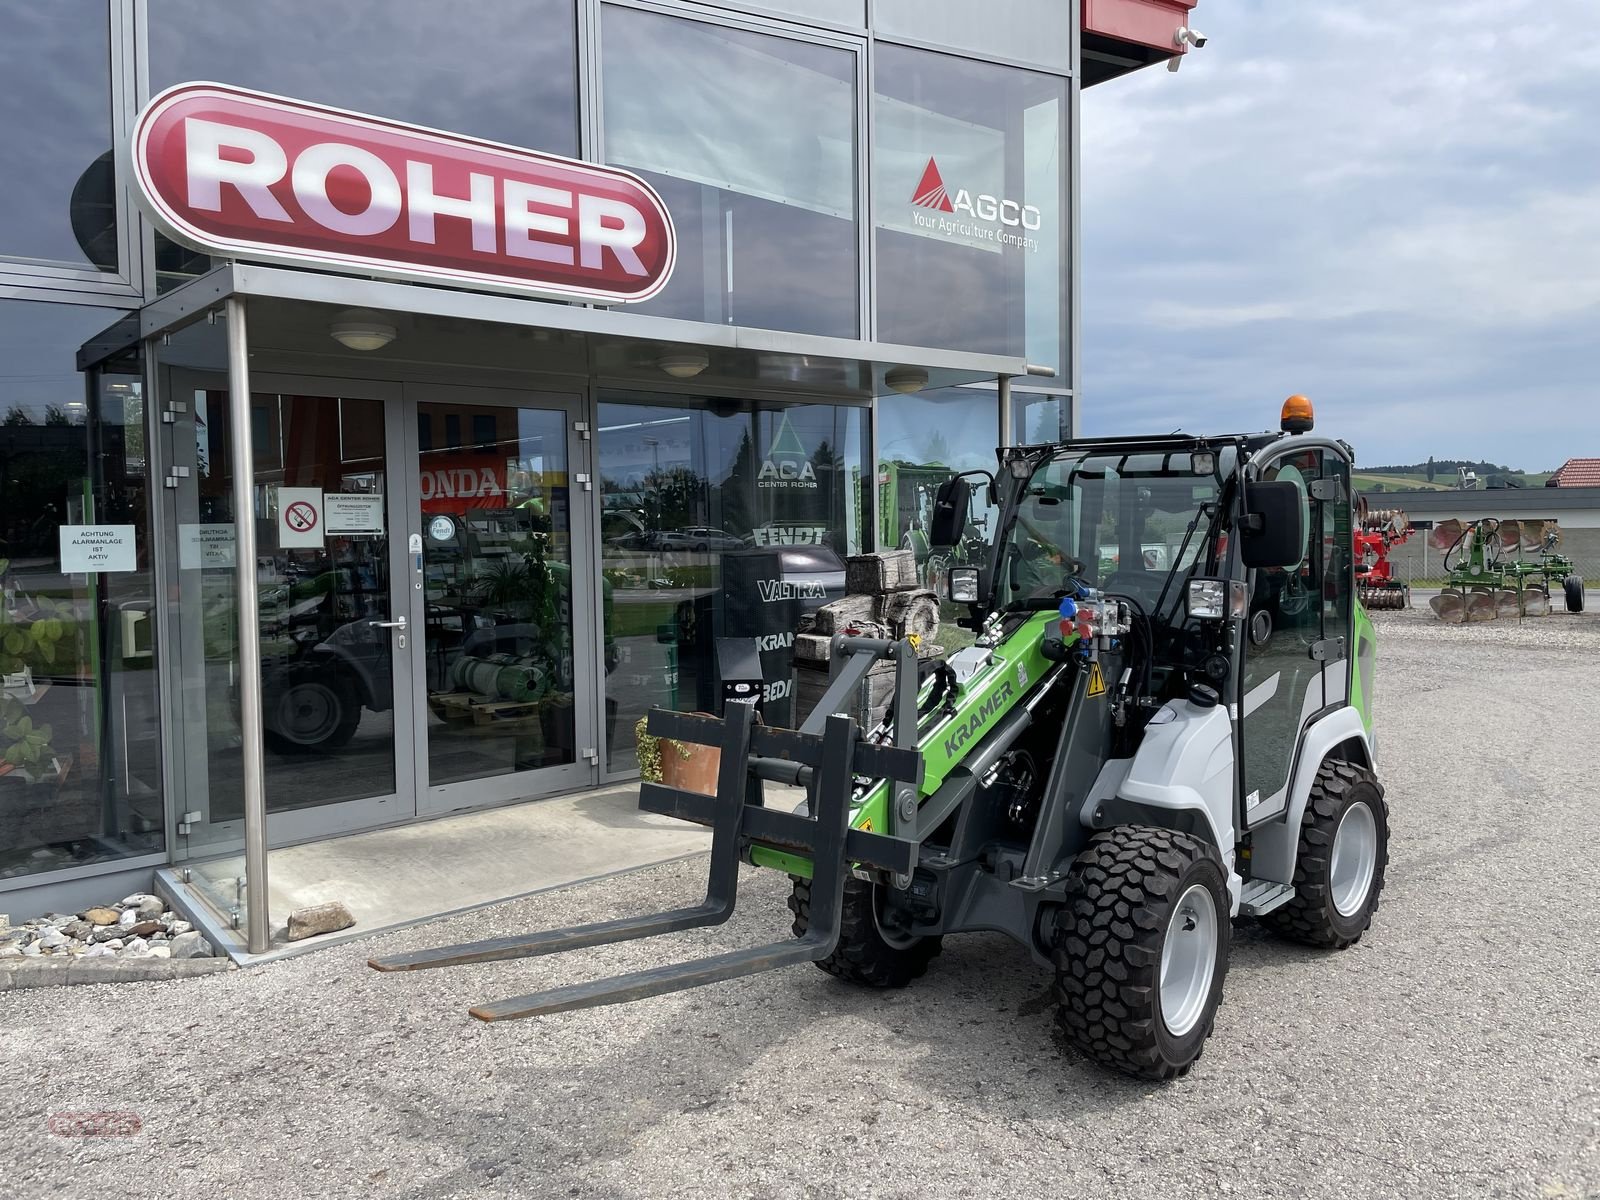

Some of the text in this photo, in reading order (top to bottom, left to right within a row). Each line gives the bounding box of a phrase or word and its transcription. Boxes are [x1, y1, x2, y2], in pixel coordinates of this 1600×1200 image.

[184, 116, 650, 278] ROHER
[953, 188, 1041, 231] AGCO
[912, 211, 1040, 253] Your Agriculture Company
[420, 467, 502, 500] ONDA
[757, 460, 817, 480] ACA
[791, 481, 818, 489] ROHER
[752, 527, 826, 547] FENDT
[757, 579, 827, 602] VALTRA
[944, 680, 1014, 759] KRAMER
